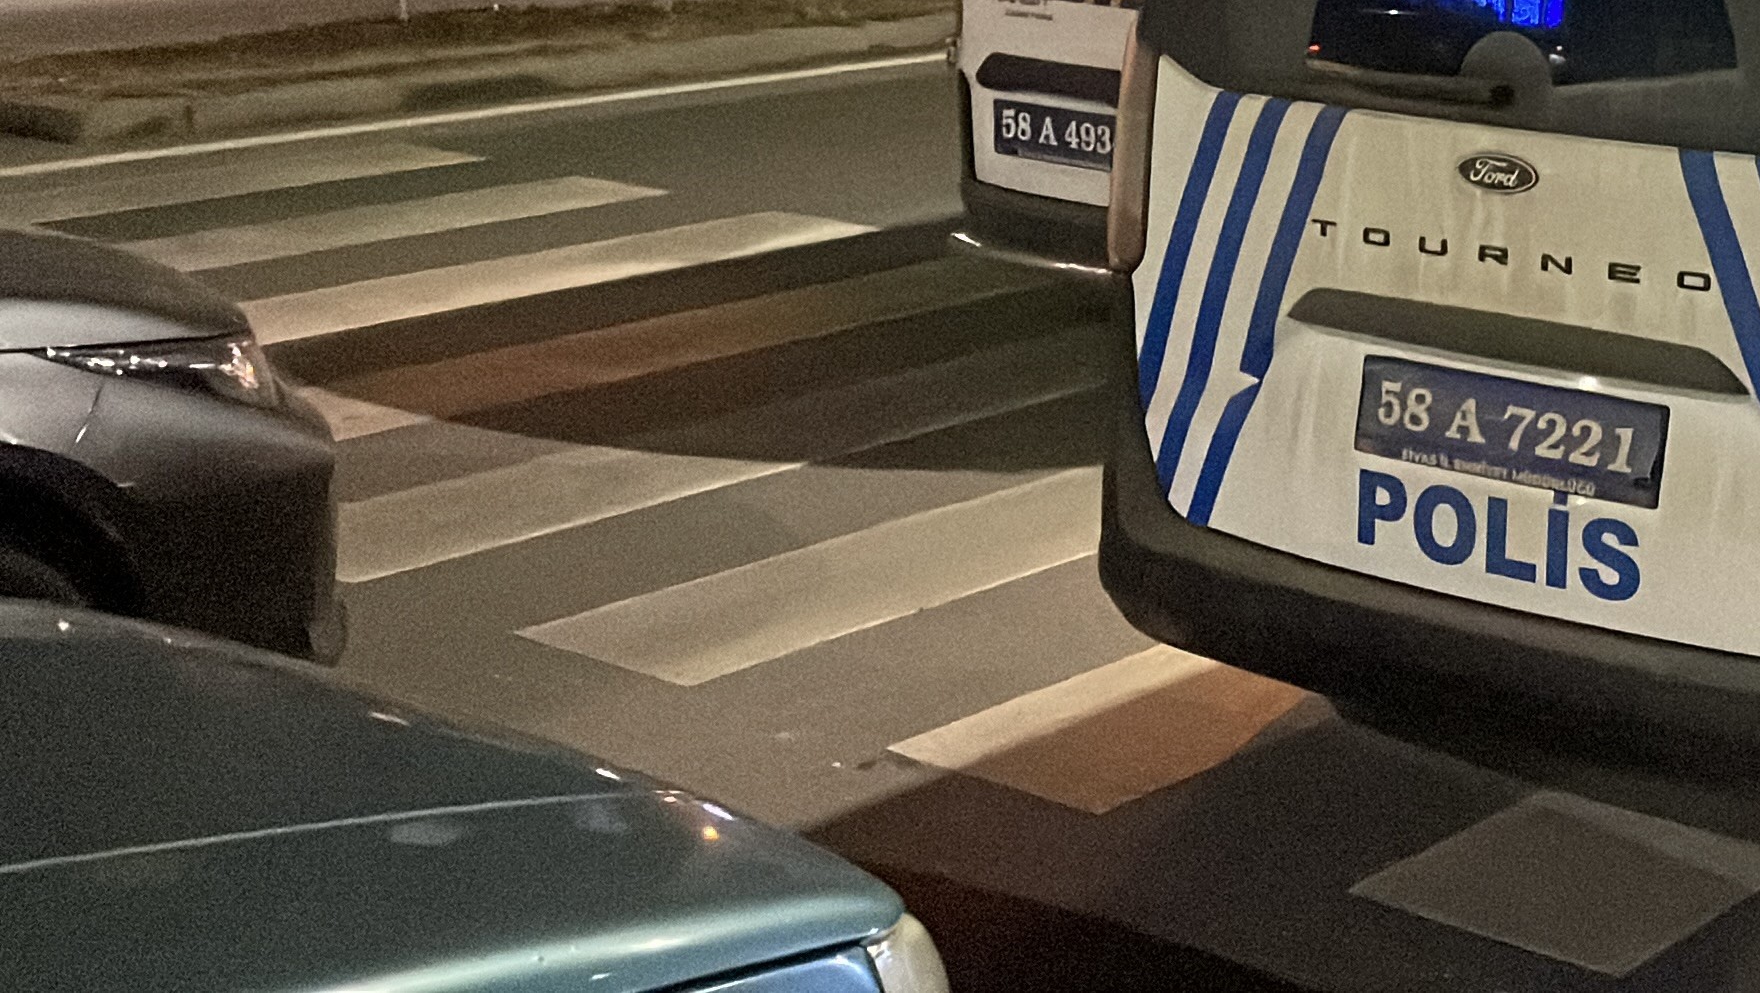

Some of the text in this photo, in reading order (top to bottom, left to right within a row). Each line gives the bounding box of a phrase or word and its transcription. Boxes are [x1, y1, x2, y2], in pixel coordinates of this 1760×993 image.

[1001, 108, 1115, 155] 58 A 493
[1470, 158, 1519, 187] Ford
[1312, 218, 1712, 292] TOURNEO
[1378, 378, 1635, 474] 58 A 7221
[1357, 467, 1641, 602] POLİS
